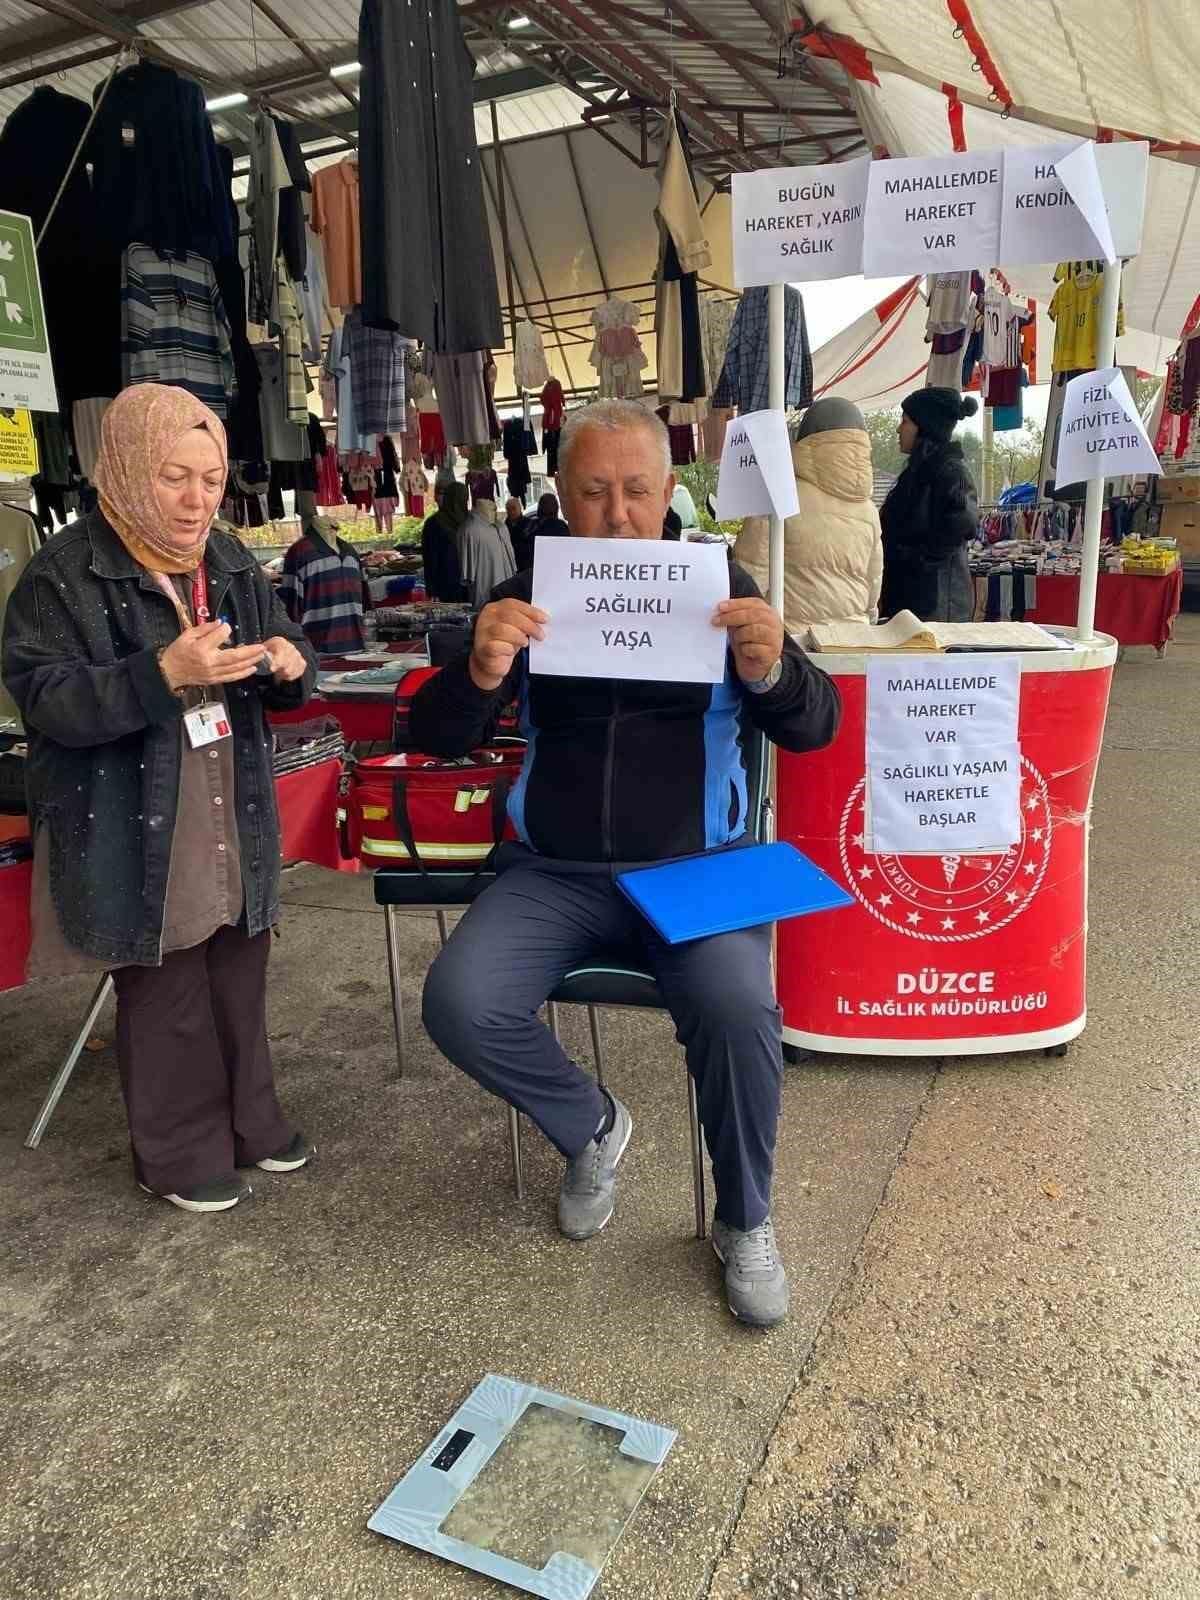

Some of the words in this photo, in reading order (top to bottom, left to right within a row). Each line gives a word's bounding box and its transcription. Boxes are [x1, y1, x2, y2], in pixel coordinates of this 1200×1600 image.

[885, 169, 998, 194] MAHALLEMDE
[778, 182, 835, 202] BUGÜN
[905, 202, 976, 222] HAREKET
[746, 214, 813, 232] HAREKET
[780, 237, 834, 256] SAĞLIK
[923, 234, 956, 249] VAR
[1066, 411, 1119, 436] AKTİVİTE
[1086, 435, 1139, 453] UZATIR
[569, 562, 662, 581] HAREKET
[668, 564, 691, 581] ET
[585, 593, 672, 614] SAĞLIKLI
[601, 630, 653, 651] YAŞA
[887, 676, 998, 692] MAHALLEMDE
[906, 703, 977, 718] HAREKET
[925, 730, 957, 743] VAR
[883, 764, 949, 780] SAĞLIKLI
[953, 759, 1008, 777] YAŞAM
[904, 786, 989, 803] HAREKETLE
[919, 811, 977, 828] BAŞLAR
[880, 854, 920, 899] TÜRKİY
[897, 968, 995, 994] DÜZCE
[837, 996, 853, 1015] İL
[859, 998, 927, 1016] SAĞLIK
[931, 991, 1048, 1016] MÜDÜRLÜĞÜ
